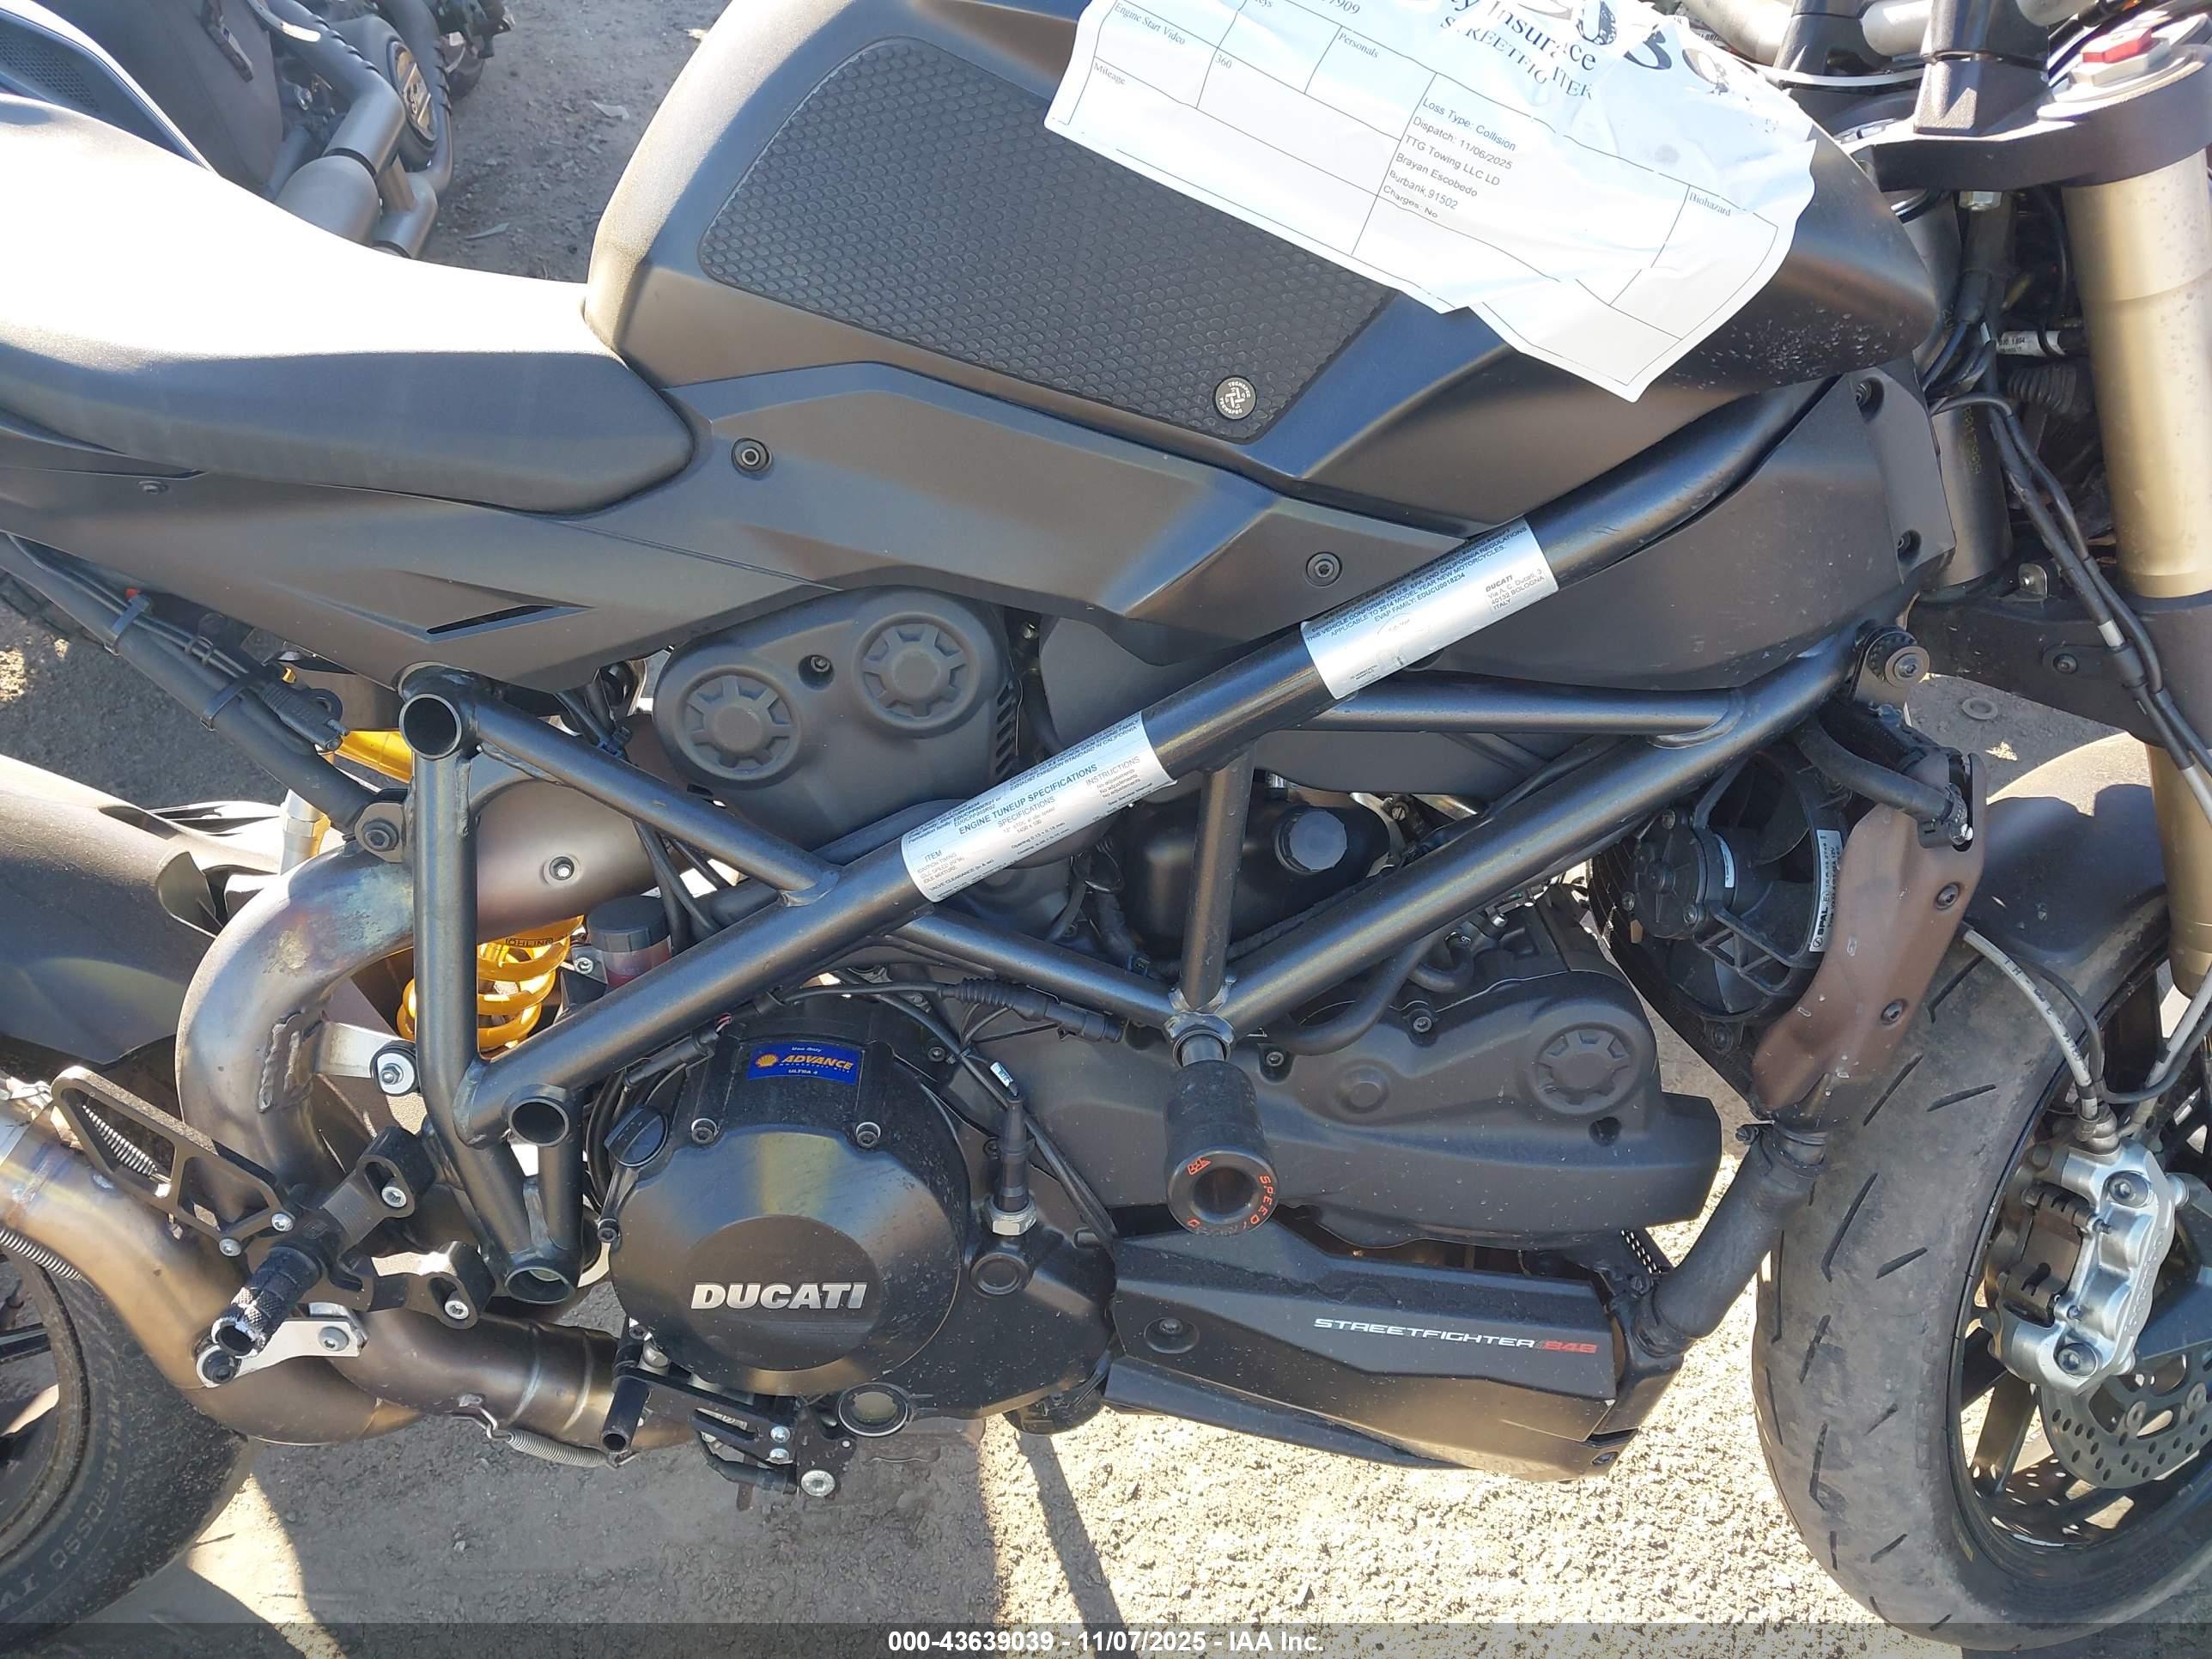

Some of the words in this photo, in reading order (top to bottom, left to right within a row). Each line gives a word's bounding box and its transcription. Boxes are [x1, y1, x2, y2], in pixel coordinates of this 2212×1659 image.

[1112, 2, 1142, 23] Engine
[1140, 15, 1162, 33] Start
[1160, 25, 1187, 46] Video
[1336, 31, 1380, 59] Personals
[1091, 62, 1127, 86] Mileage
[1214, 53, 1233, 70] 360
[1421, 96, 1446, 115] Loss
[1446, 109, 1475, 131] Type:
[1474, 123, 1517, 151] Collision
[1411, 116, 1458, 145] Dispatch:
[1457, 138, 1513, 171] 11/06/2025
[1403, 134, 1426, 152] TTG
[1425, 146, 1462, 170] Towing
[1462, 162, 1484, 180] LLC
[1484, 173, 1501, 186] LD
[1395, 152, 1430, 176] Brayan
[1429, 168, 1479, 198] Escobedo
[1387, 169, 1459, 211] Burbank,91502
[1688, 191, 1732, 218] Biohazard
[1423, 206, 1439, 219] No
[1307, 631, 1322, 641] THIS
[1322, 617, 1348, 634] VEHICLE
[1348, 599, 1385, 620] CONFORMS
[1410, 578, 1425, 589] EPA
[1424, 570, 1439, 581] AND
[1439, 550, 1480, 574] CALIFORNIA
[1478, 526, 1527, 554] REGULATIONS
[1485, 574, 1513, 592] DUCATI
[1510, 574, 1545, 595] BOLOGNA
[1330, 614, 1369, 636] APPLICABLE
[1369, 608, 1379, 617] TO
[1378, 601, 1394, 612] 2014
[1393, 588, 1418, 605] MODEL
[1418, 579, 1436, 592] YEAR
[1436, 569, 1454, 582] NEW
[1374, 610, 1391, 622] EVAP
[1391, 597, 1416, 613] FAMILY:
[1493, 598, 1511, 610] ITALY
[1009, 775, 1035, 791] EXHAUST
[1036, 761, 1065, 778] EMISSION
[1064, 745, 1097, 763] STANDARD
[1103, 725, 1138, 744] CALIFORNIA
[1085, 755, 1140, 787] INSTRUCTIONS
[957, 814, 992, 835] ENGINE
[991, 797, 1027, 819] TUNEUP
[1026, 763, 1097, 803] SPECIFICATIONS
[996, 794, 1055, 828] SPECIFICATIONS
[923, 848, 942, 862] ITEM
[945, 867, 974, 884] CLEARANCE
[1817, 906, 1828, 935] SPAL
[781, 1054, 854, 1070] ADVANCE
[690, 1282, 869, 1310] DUCATI
[1314, 1318, 1535, 1348] STREETFIGHTER
[1540, 1341, 1598, 1353] 848
